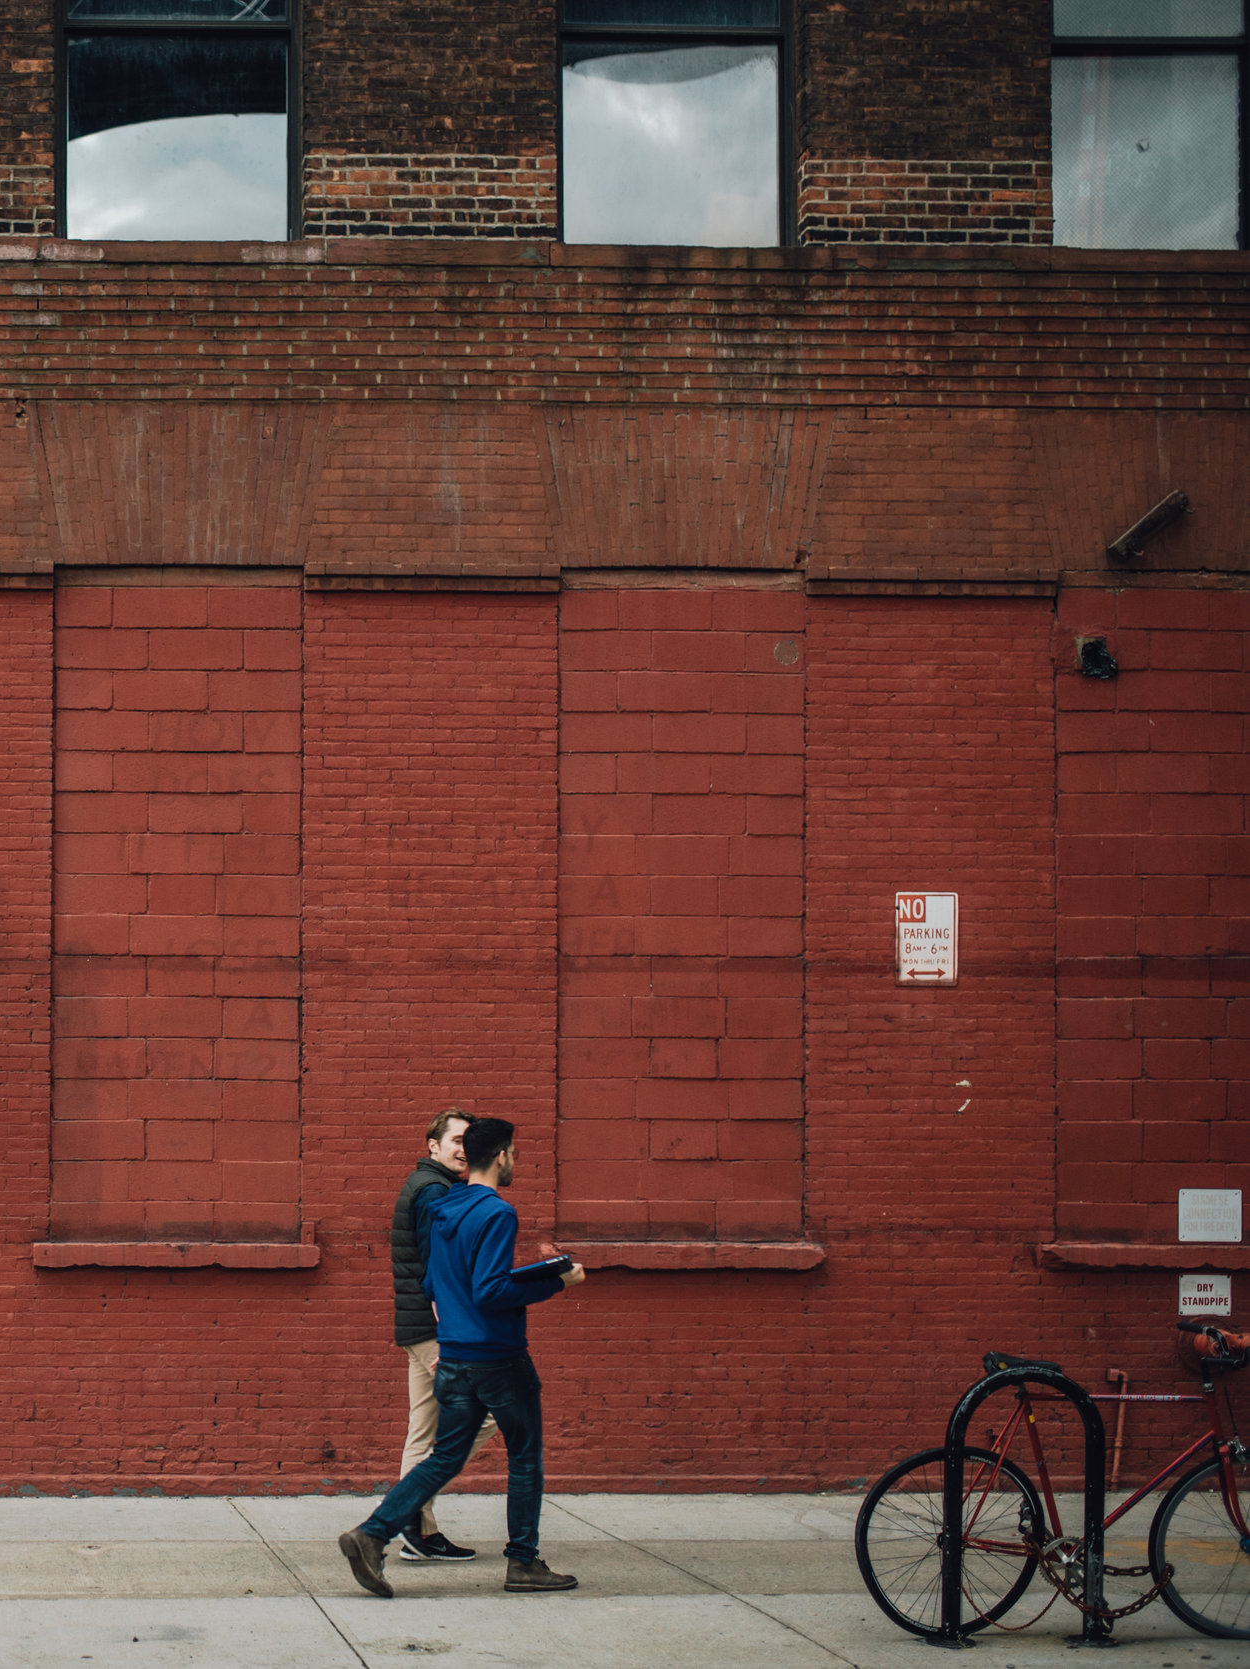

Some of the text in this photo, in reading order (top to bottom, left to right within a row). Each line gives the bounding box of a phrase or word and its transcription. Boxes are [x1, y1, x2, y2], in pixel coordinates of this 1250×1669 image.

[899, 898, 924, 919] NO
[904, 928, 949, 939] PARKING
[1192, 1194, 1229, 1206] SIAMESE
[1182, 1207, 1239, 1219] CONNECTION
[1183, 1221, 1198, 1232] FOR
[1199, 1221, 1215, 1232] FIRE
[1197, 1283, 1214, 1292] DRY
[1182, 1297, 1229, 1306] STANDPIPE
